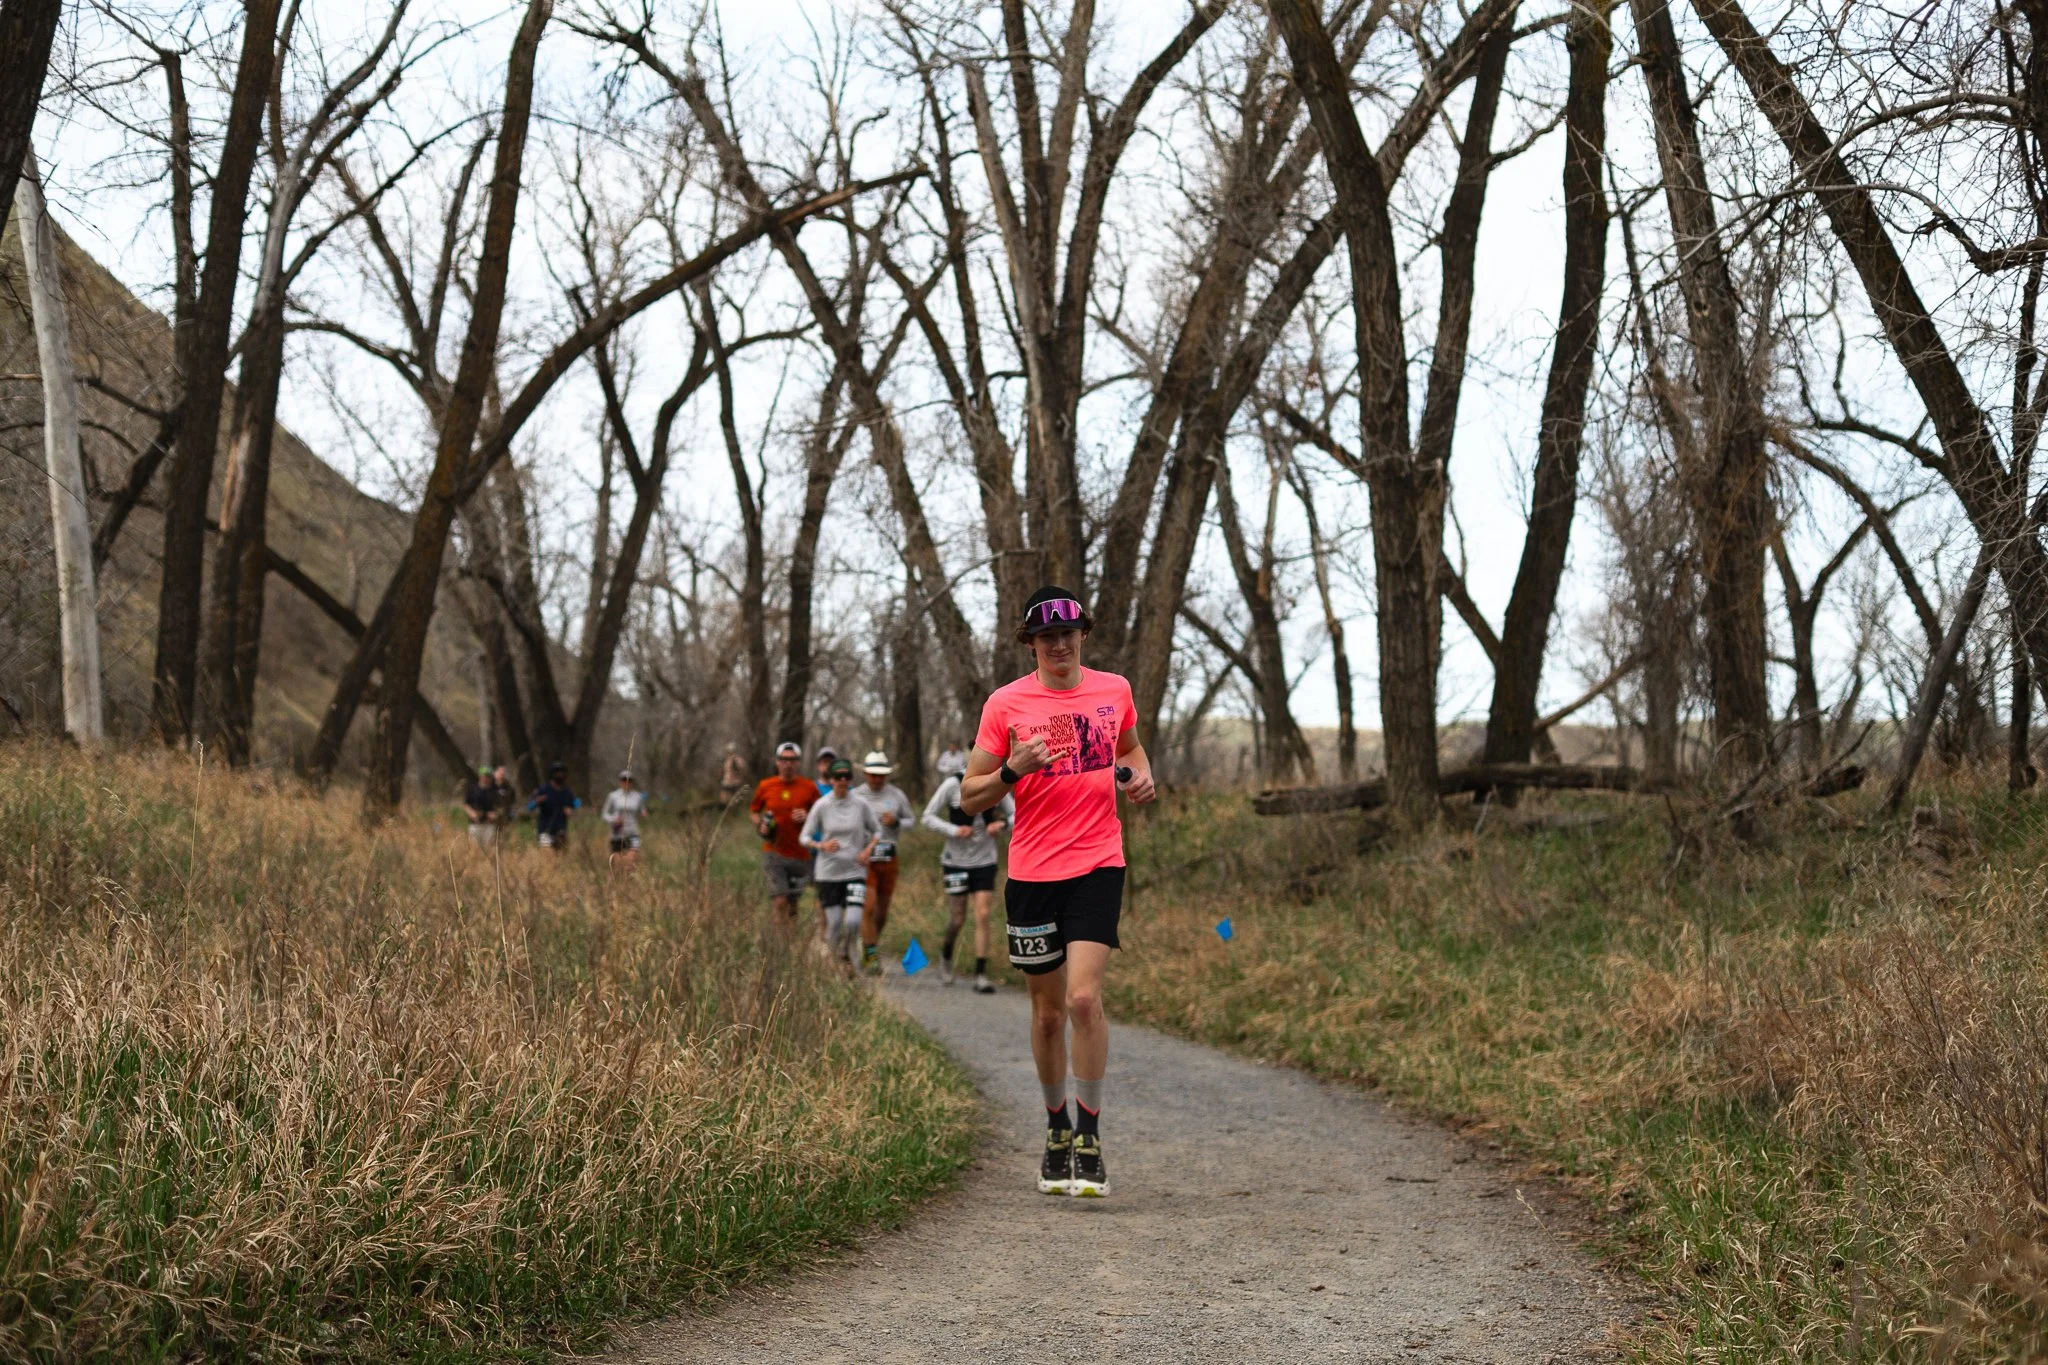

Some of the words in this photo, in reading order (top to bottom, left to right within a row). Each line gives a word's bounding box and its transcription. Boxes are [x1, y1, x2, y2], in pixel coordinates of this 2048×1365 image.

[1049, 714, 1071, 723] YOUTH
[1030, 721, 1073, 735] SKYRUNNING
[1050, 729, 1074, 738] WORLD
[1043, 735, 1075, 746] MPIONSHIPS
[1015, 937, 1048, 955] 123
